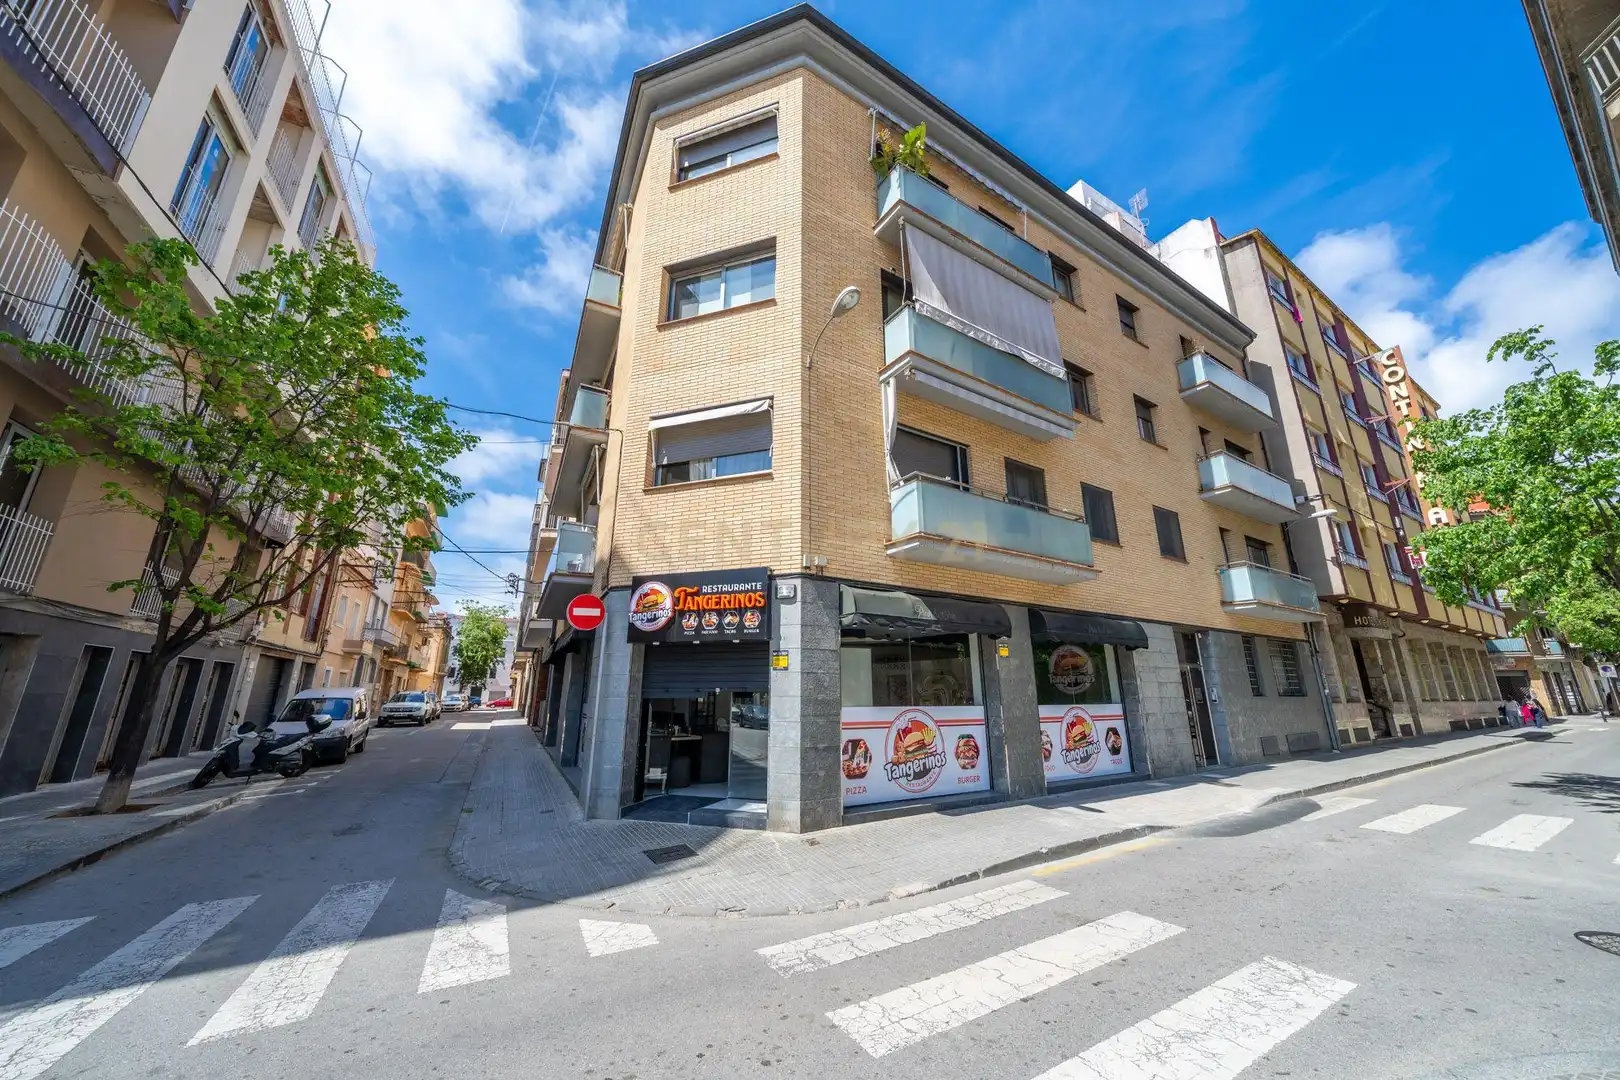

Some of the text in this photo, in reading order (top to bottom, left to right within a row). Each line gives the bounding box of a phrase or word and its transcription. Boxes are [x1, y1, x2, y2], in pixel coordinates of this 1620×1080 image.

[702, 582, 763, 593] RESTAURANTE
[674, 587, 766, 610] TANGERINOS
[628, 608, 672, 623] Tangerinos
[1060, 740, 1102, 764] Tangerinos
[884, 751, 947, 781] Tangerinos
[957, 775, 981, 785] BURGER
[845, 786, 868, 795] PIZZA
